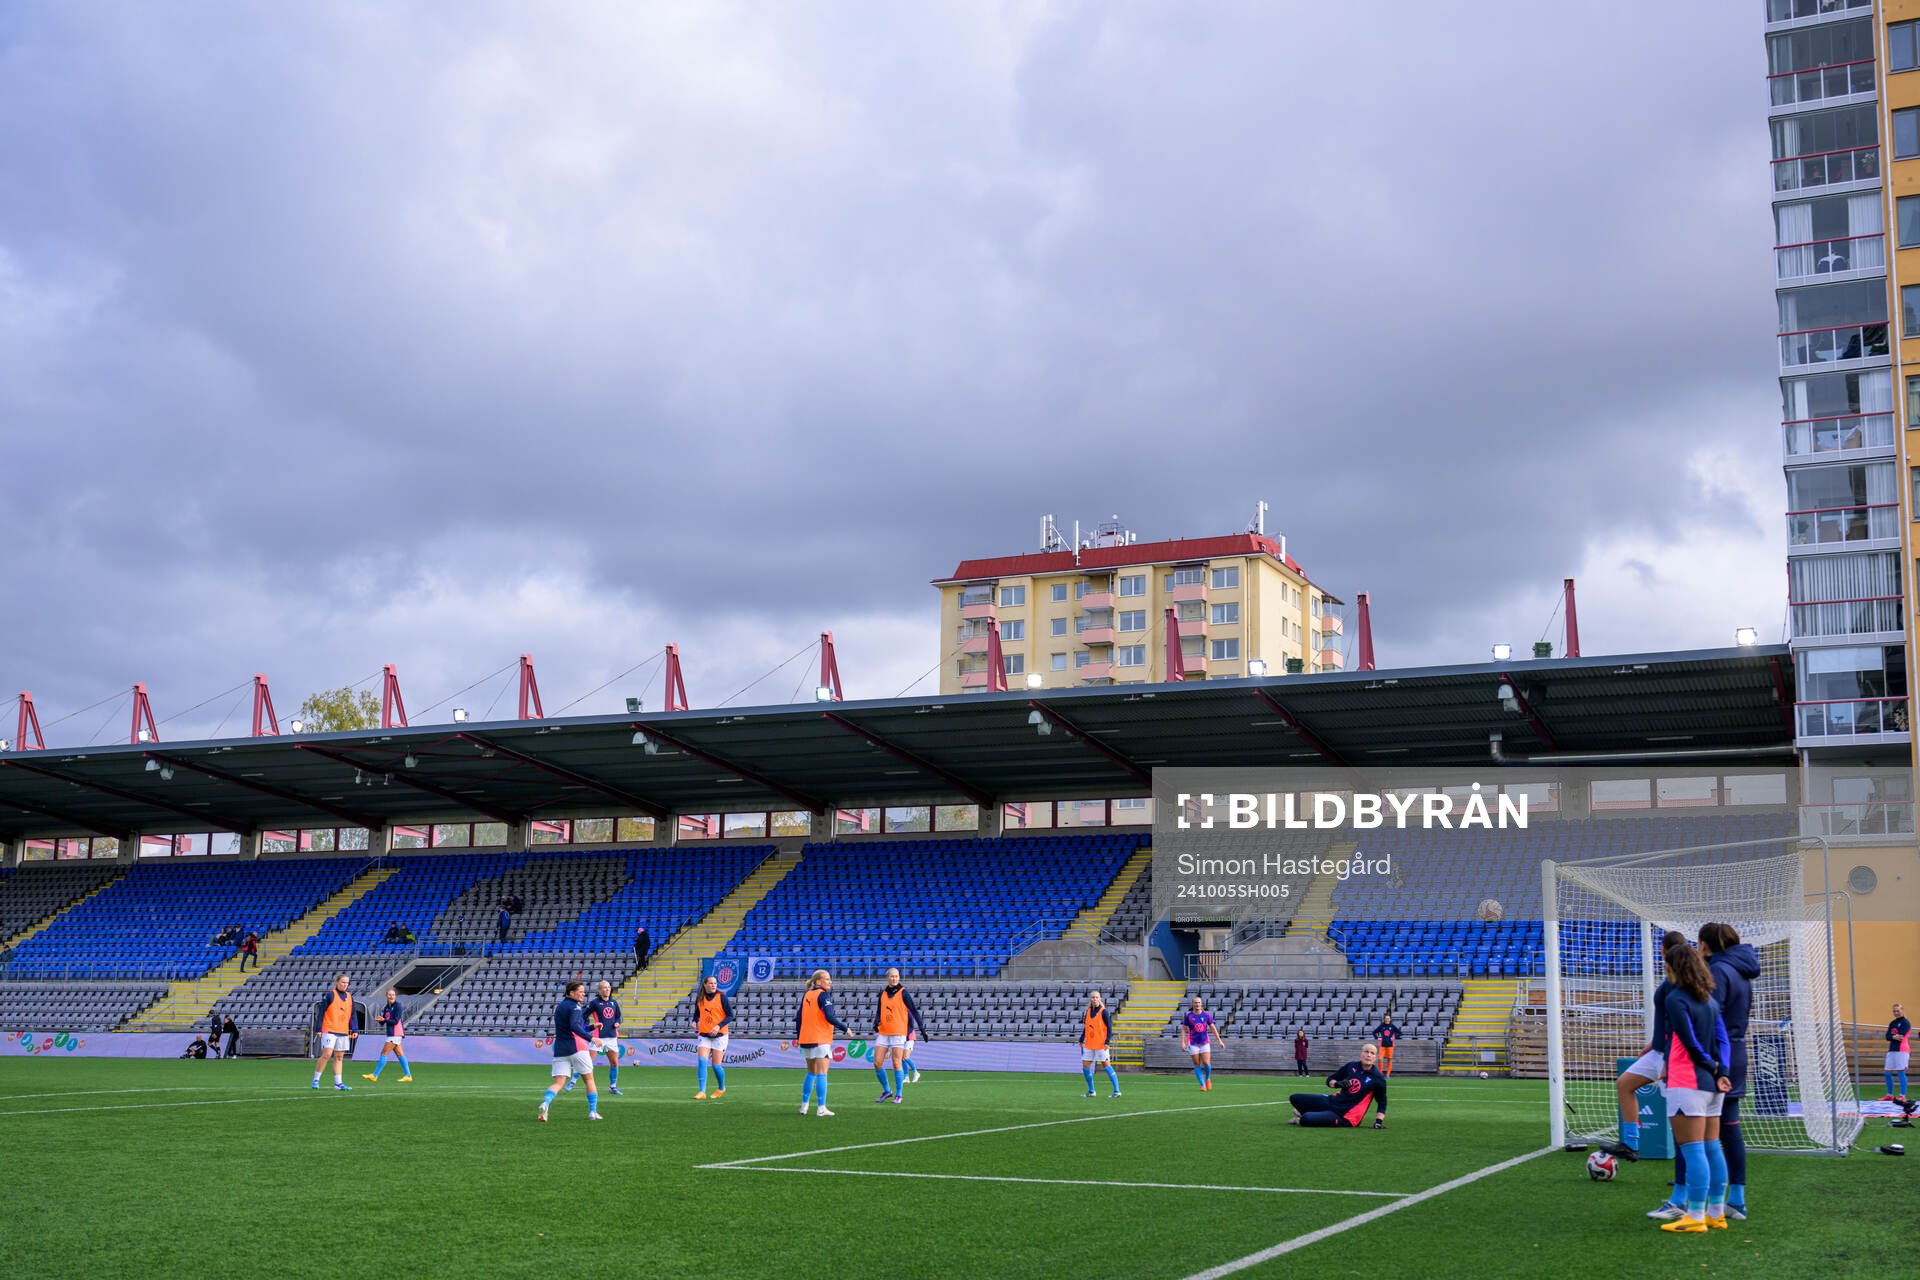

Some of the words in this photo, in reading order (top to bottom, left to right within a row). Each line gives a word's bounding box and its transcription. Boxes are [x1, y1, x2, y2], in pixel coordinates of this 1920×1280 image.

[649, 1046, 657, 1055] VI
[675, 1042, 698, 1054] ESKILS
[721, 1047, 766, 1064] LLSAMMANS
